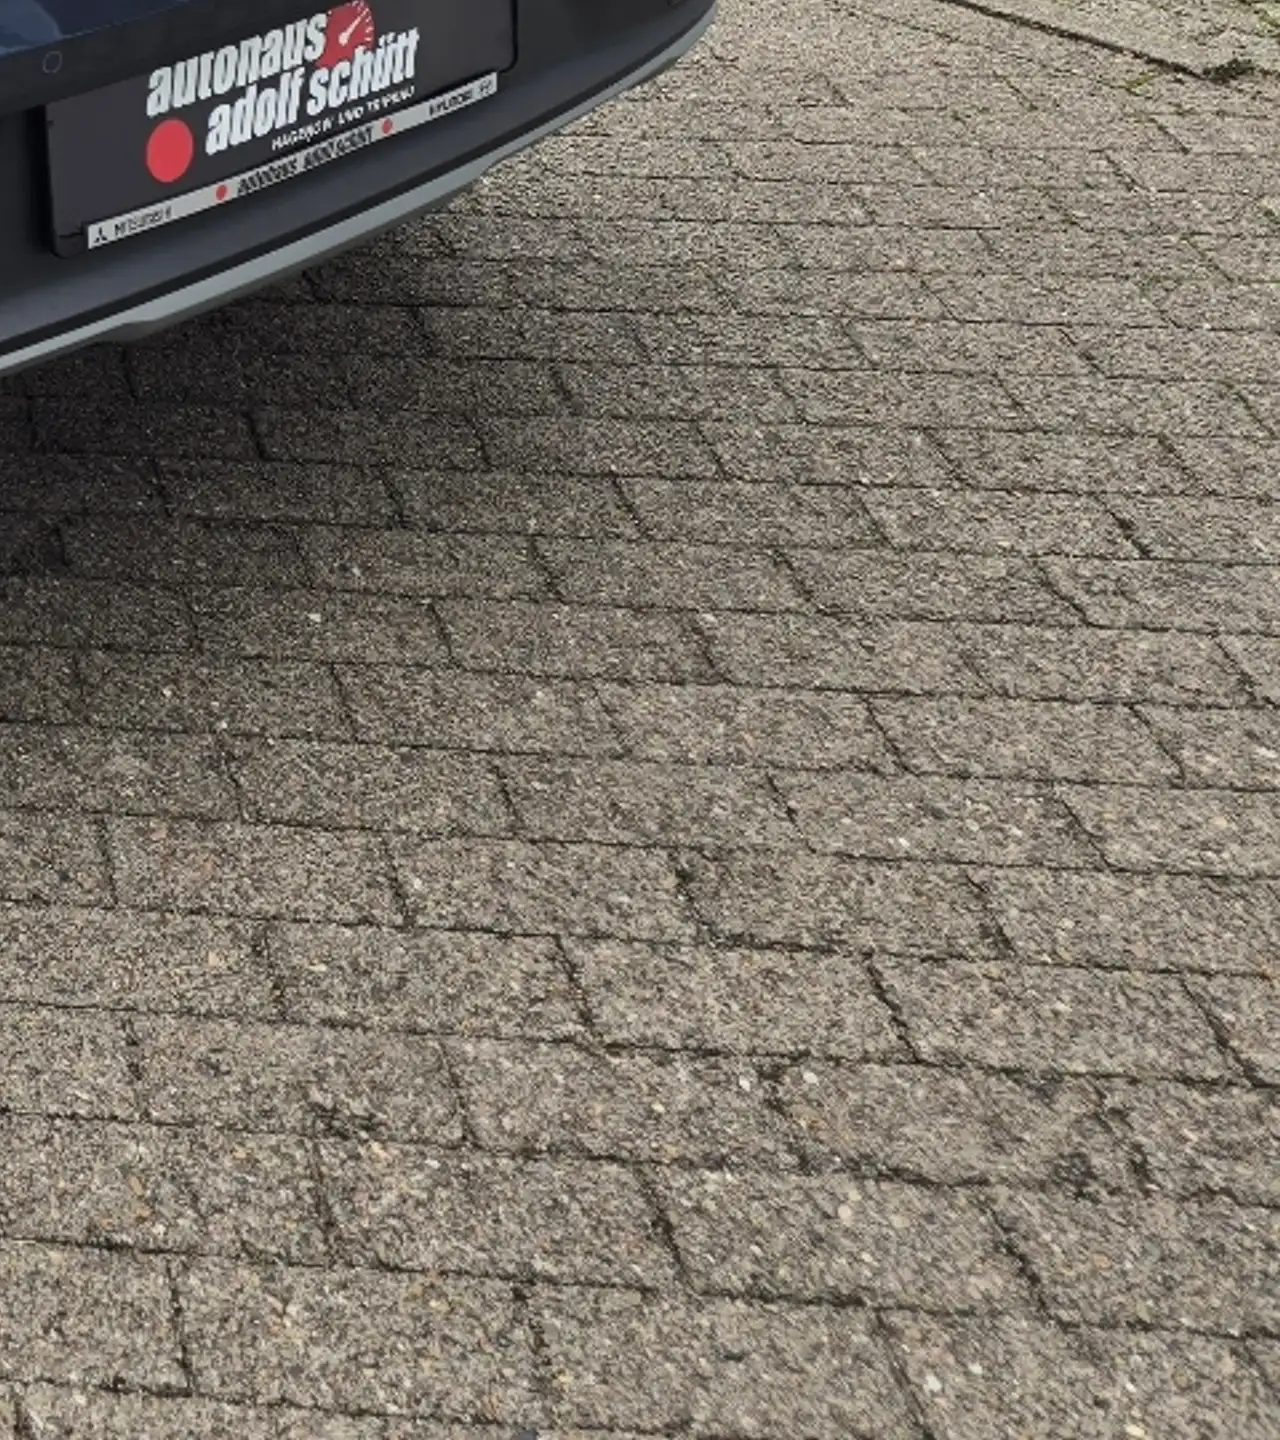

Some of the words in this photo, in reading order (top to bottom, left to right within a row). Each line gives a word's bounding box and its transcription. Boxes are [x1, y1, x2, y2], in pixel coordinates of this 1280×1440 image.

[146, 12, 328, 117] autohaus
[205, 65, 306, 157] adolf
[307, 27, 421, 117] schütt
